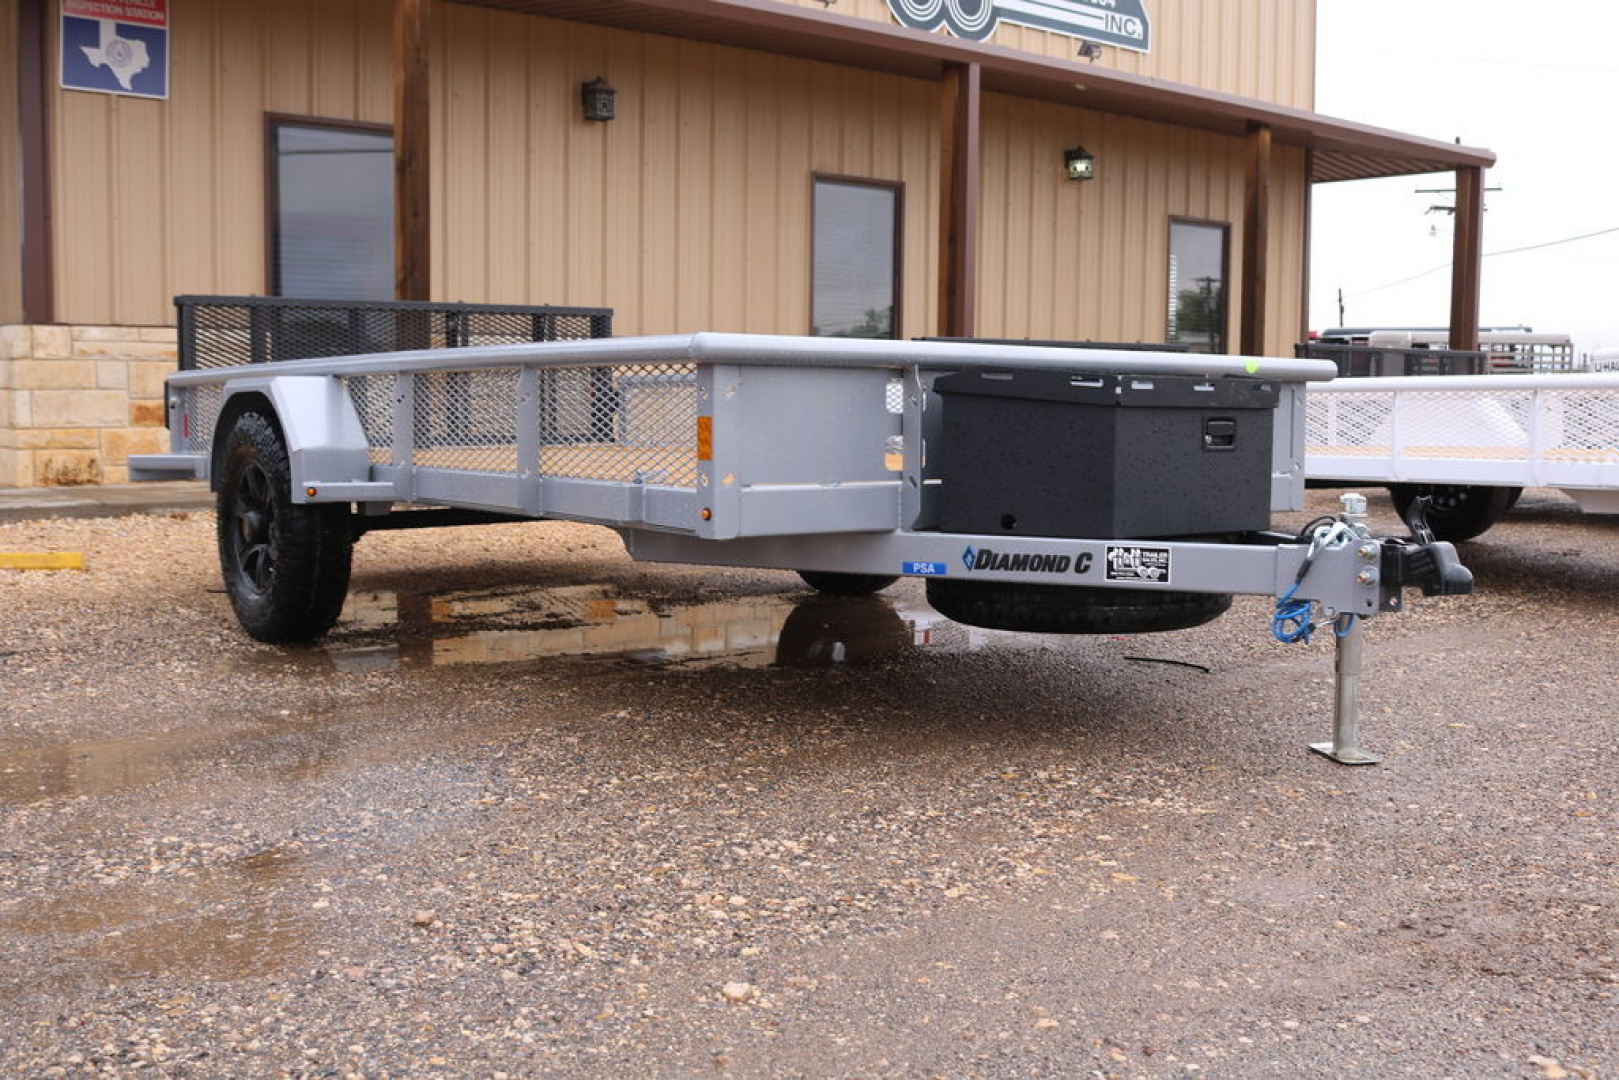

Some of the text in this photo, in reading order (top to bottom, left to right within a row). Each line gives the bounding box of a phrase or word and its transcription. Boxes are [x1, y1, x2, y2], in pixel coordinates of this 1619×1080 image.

[126, 7, 165, 21] STATION
[1104, 13, 1141, 37] INC.
[913, 562, 935, 573] PSA
[974, 549, 1093, 574] DIAMOND C
